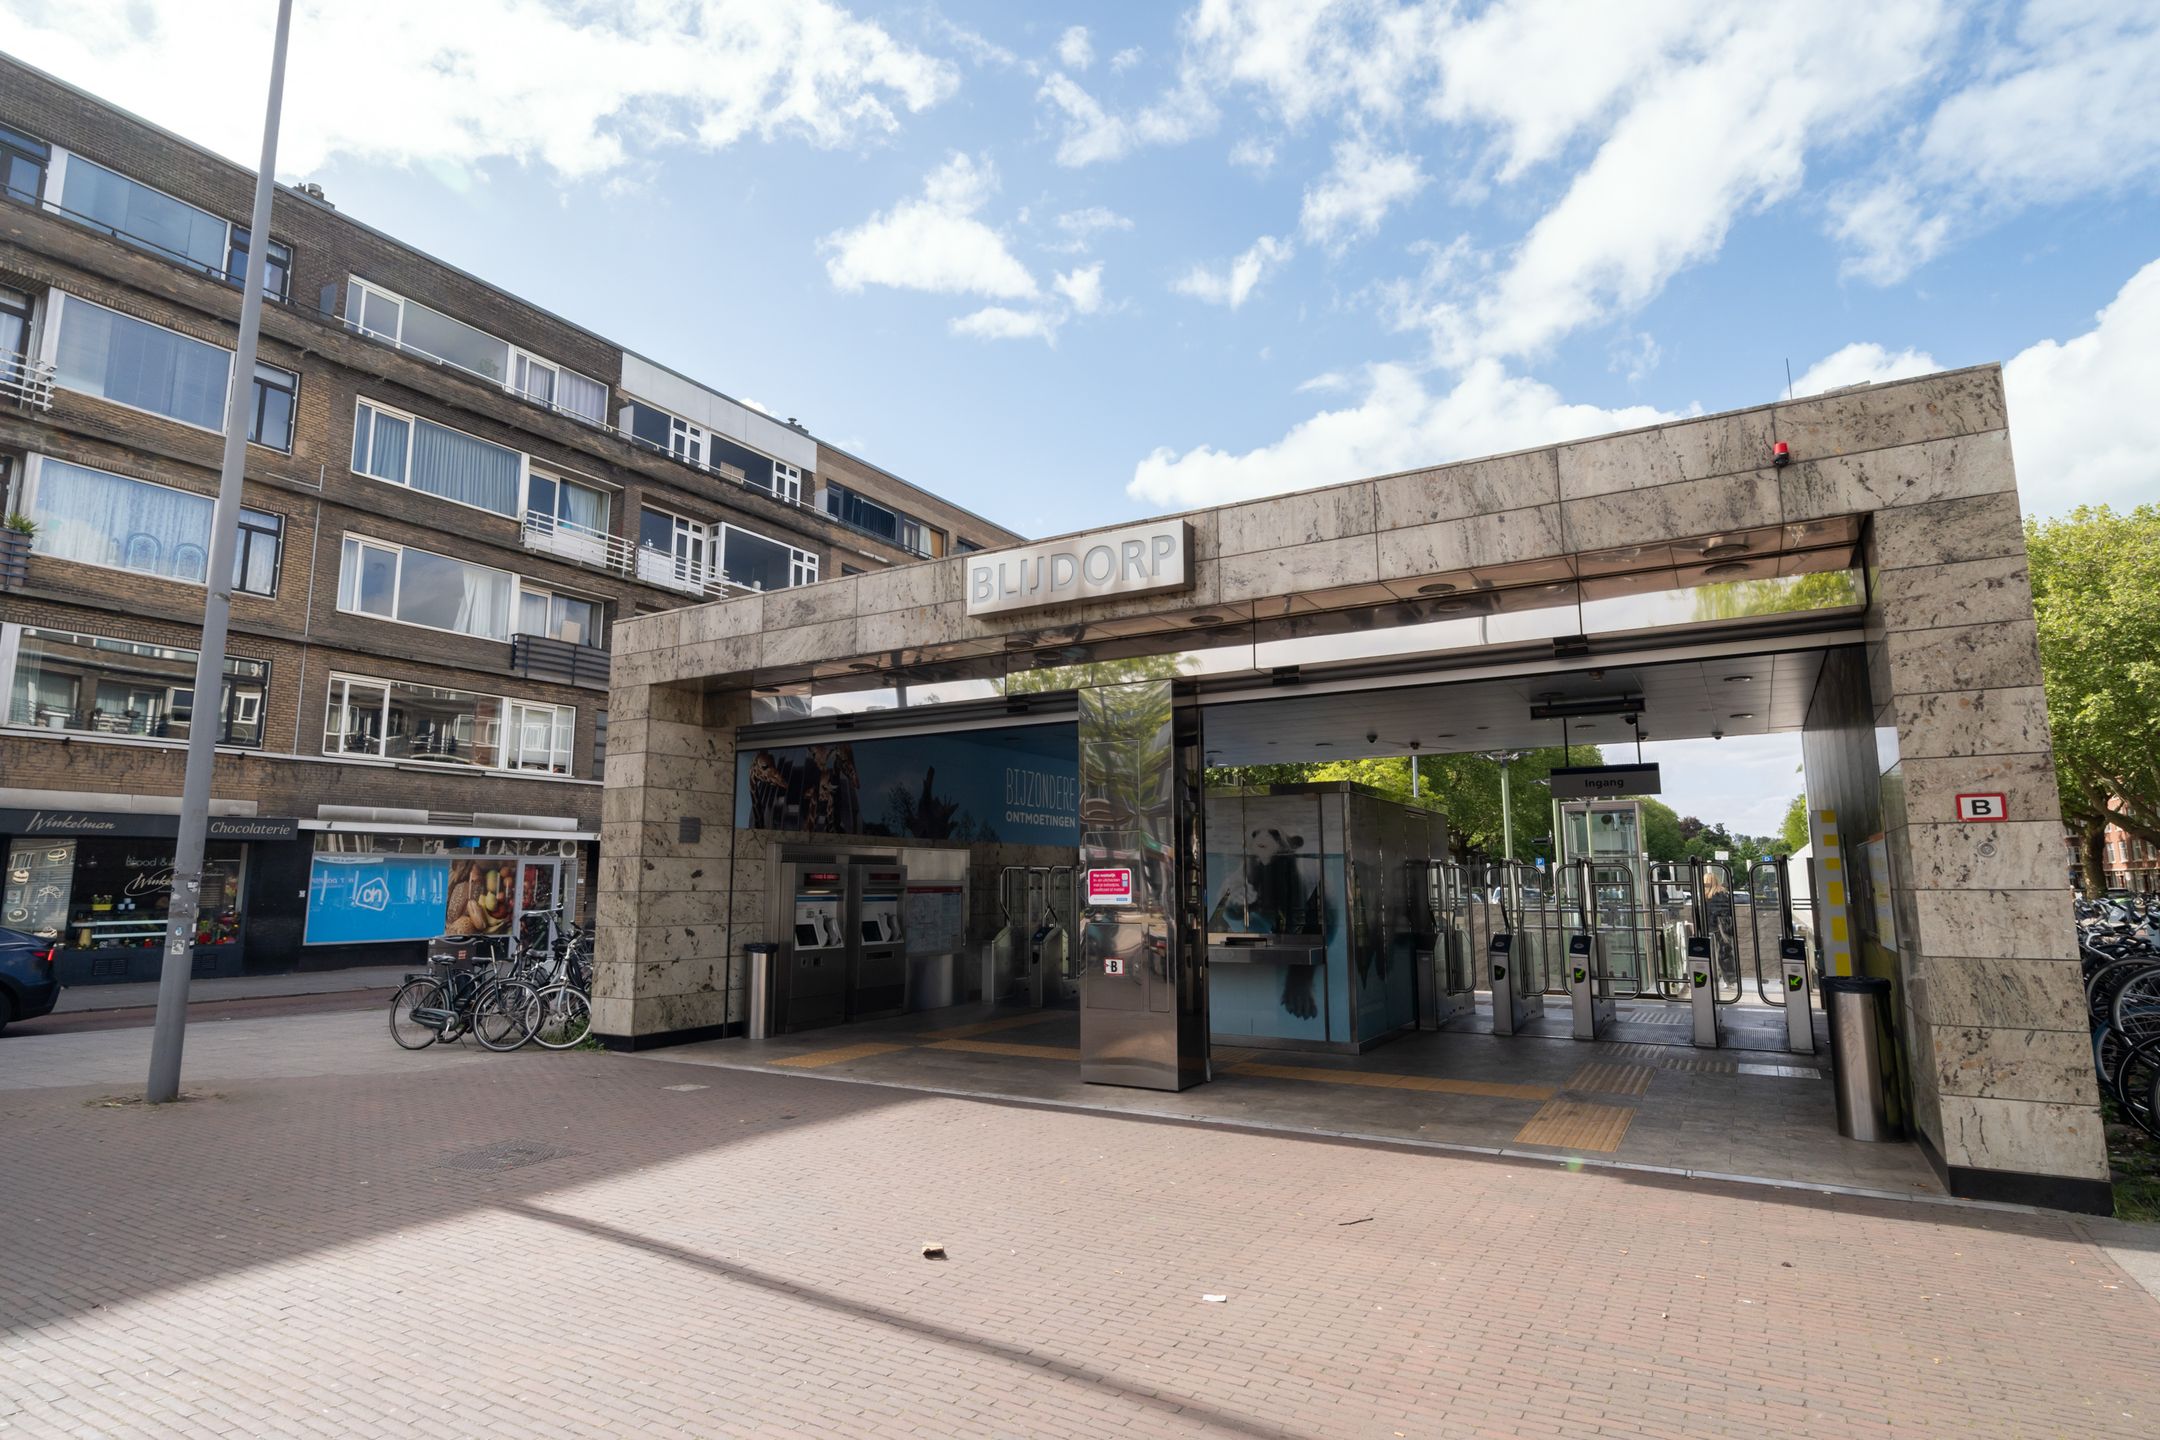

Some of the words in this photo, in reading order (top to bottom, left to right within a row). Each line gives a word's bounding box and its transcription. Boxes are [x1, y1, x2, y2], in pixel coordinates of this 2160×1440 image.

[972, 535, 1176, 603] BLIJDORP
[1006, 768, 1075, 811] BIJZONDERE
[1585, 779, 1624, 789] Ingang
[1971, 800, 1991, 815] B
[25, 812, 115, 832] Winkelman
[1006, 811, 1075, 827] ONTMOETINGEN
[210, 821, 291, 835] Chocolaterie
[1111, 960, 1118, 973] B
